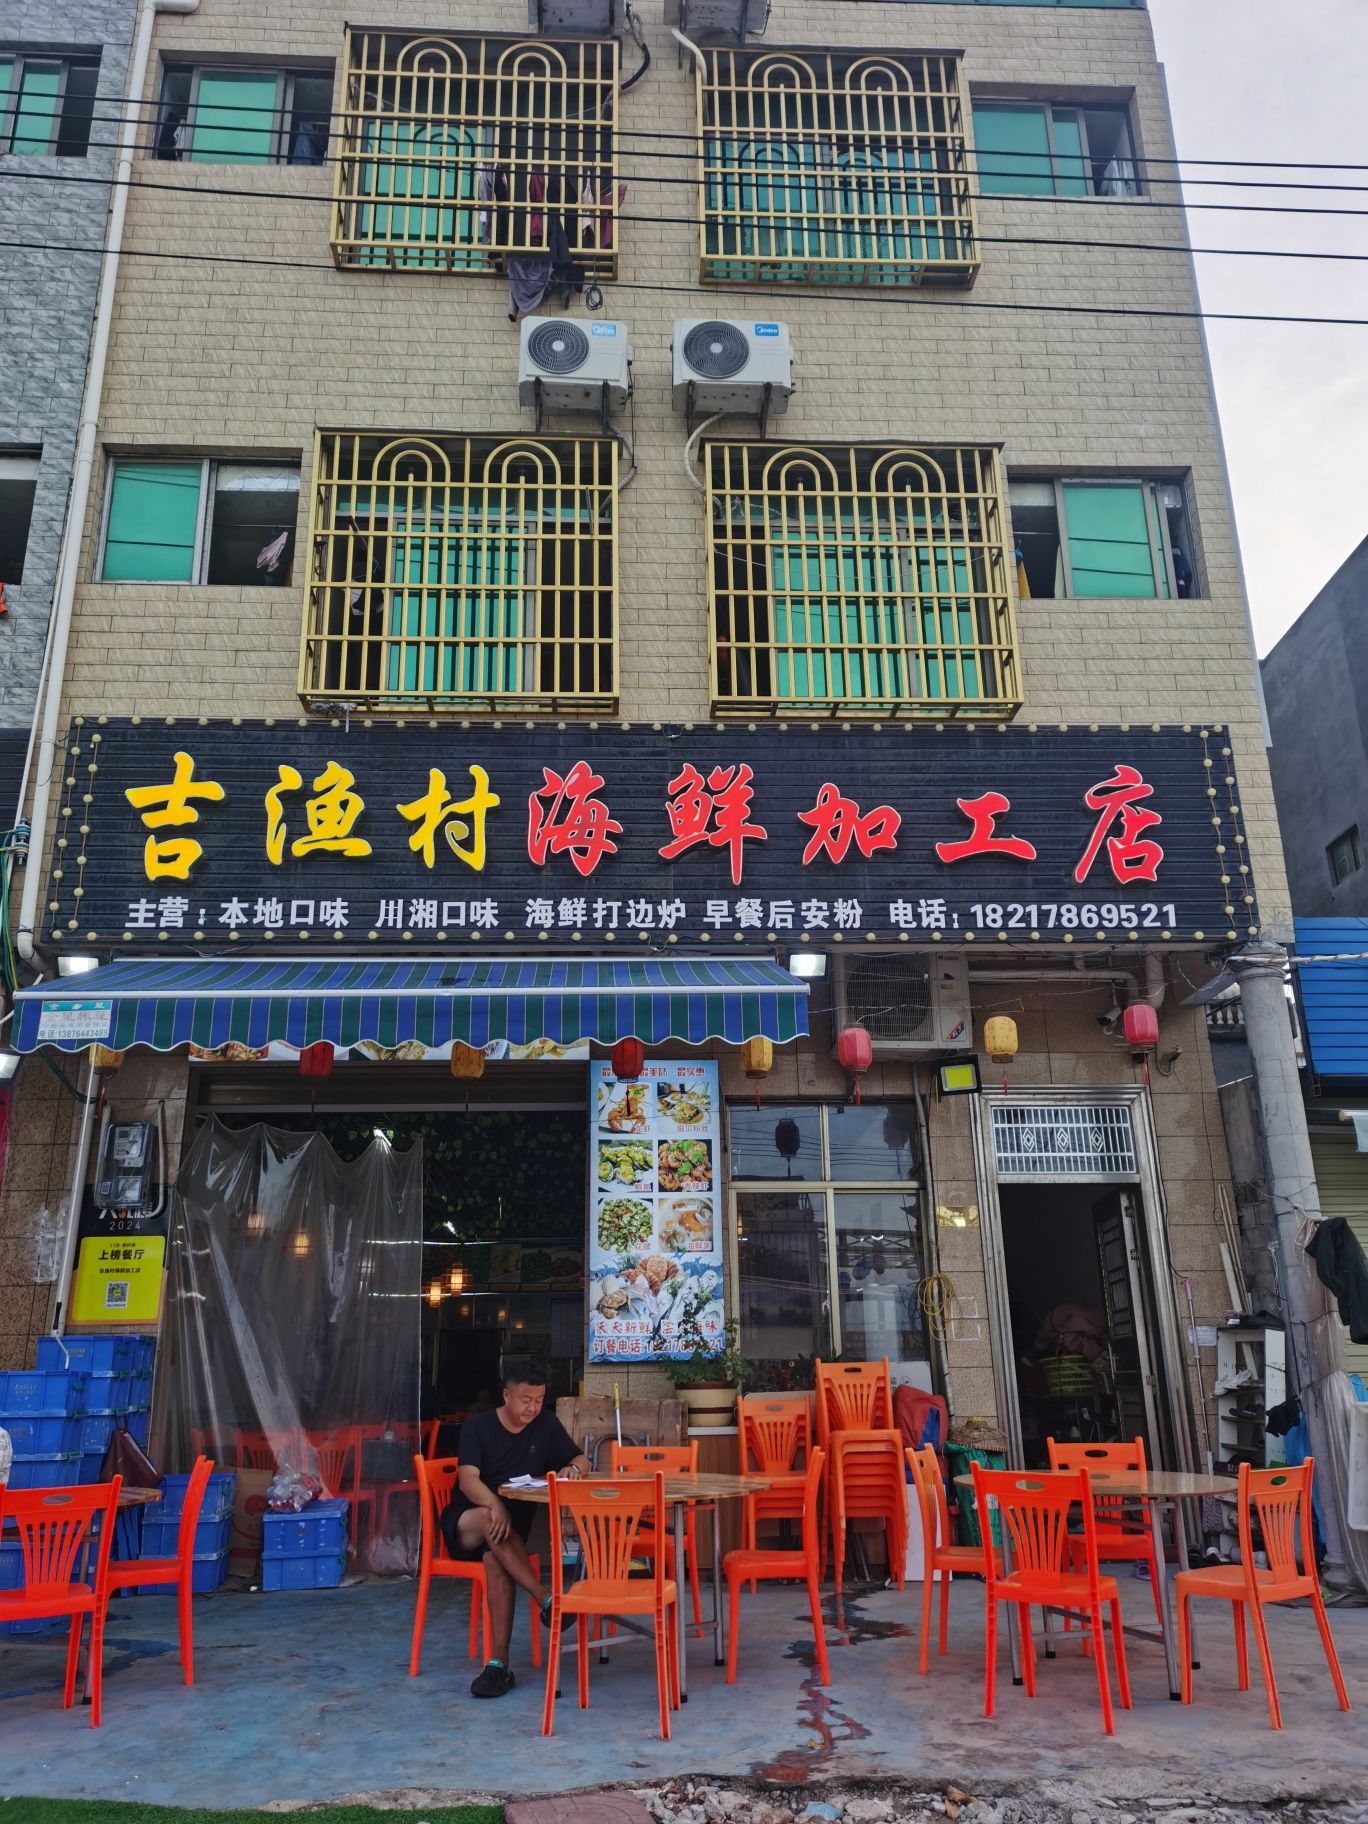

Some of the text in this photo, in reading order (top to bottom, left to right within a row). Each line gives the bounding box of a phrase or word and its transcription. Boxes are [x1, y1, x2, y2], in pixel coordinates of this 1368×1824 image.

[374, 898, 500, 929] 川湘口味
[524, 897, 687, 930] 海鲜打边炉
[702, 898, 864, 931] 早餐后安粉
[110, 1221, 141, 1230] 2024
[98, 1249, 145, 1260] 上榜餐厅
[596, 1321, 652, 1334] 天天新鲜
